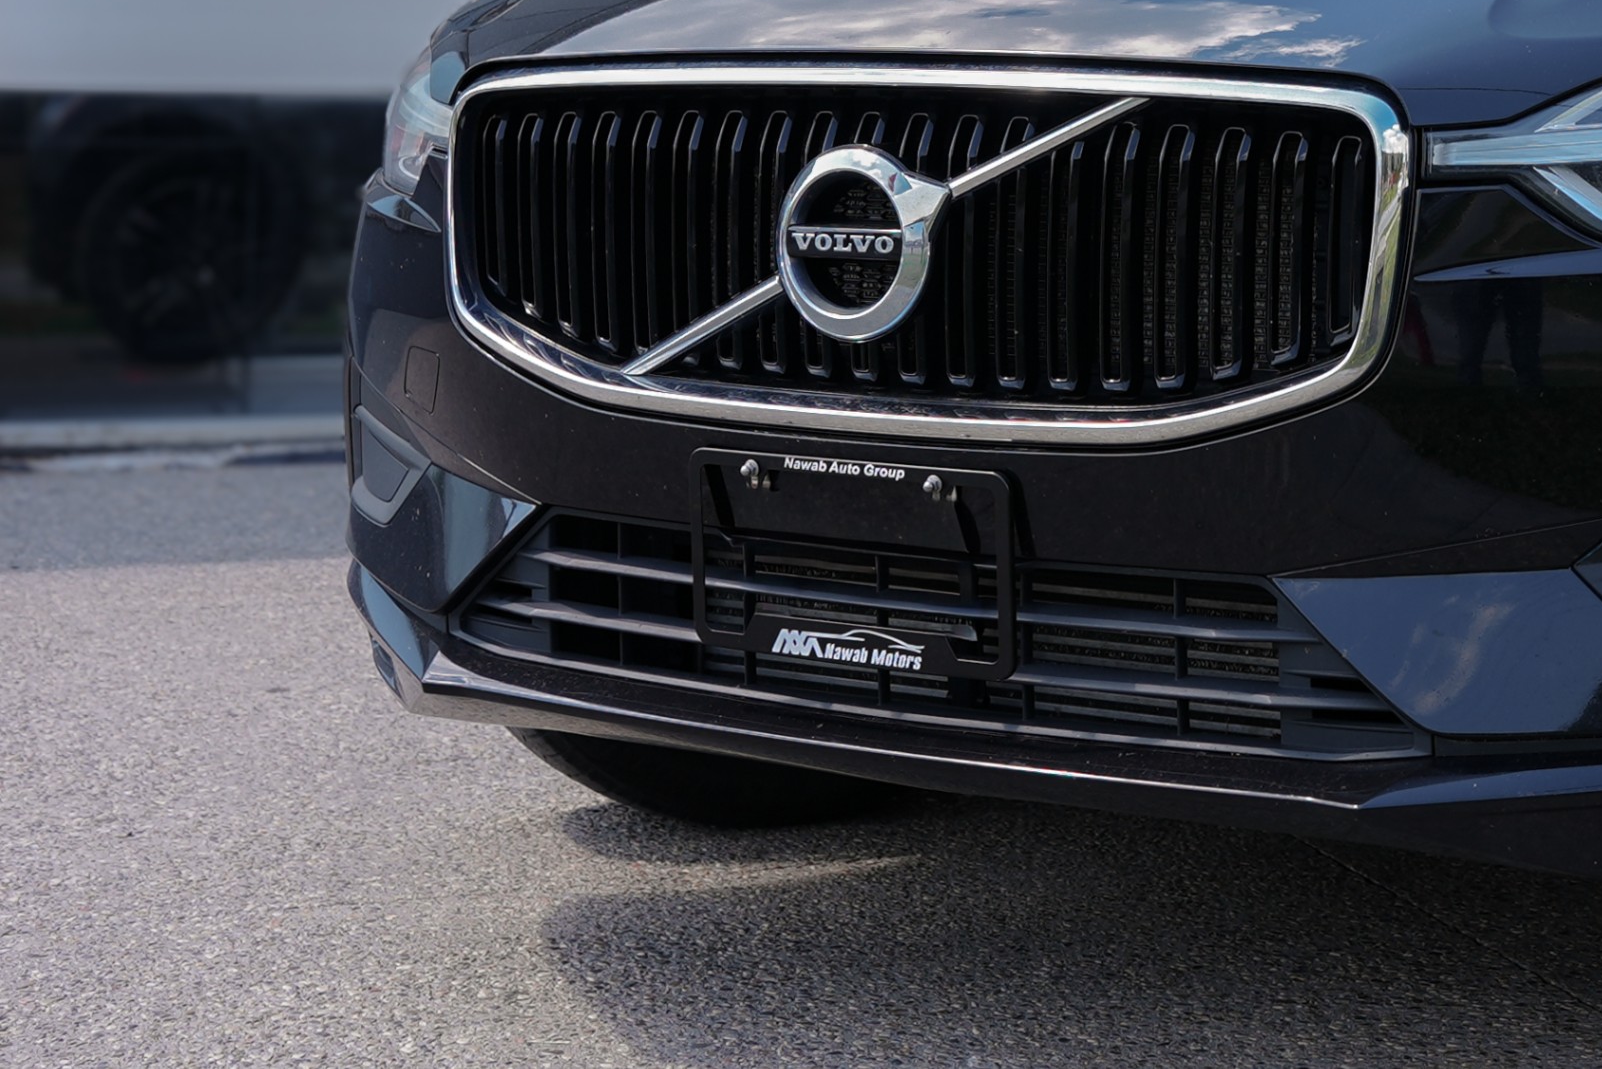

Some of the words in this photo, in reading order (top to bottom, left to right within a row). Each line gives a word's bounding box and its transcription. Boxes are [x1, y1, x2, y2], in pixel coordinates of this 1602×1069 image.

[791, 232, 895, 254] VOLVO
[783, 456, 828, 473] Nawab
[828, 461, 861, 476] Auto
[863, 463, 906, 481] Group
[824, 642, 869, 664] Nawab
[870, 648, 923, 671] Motors
